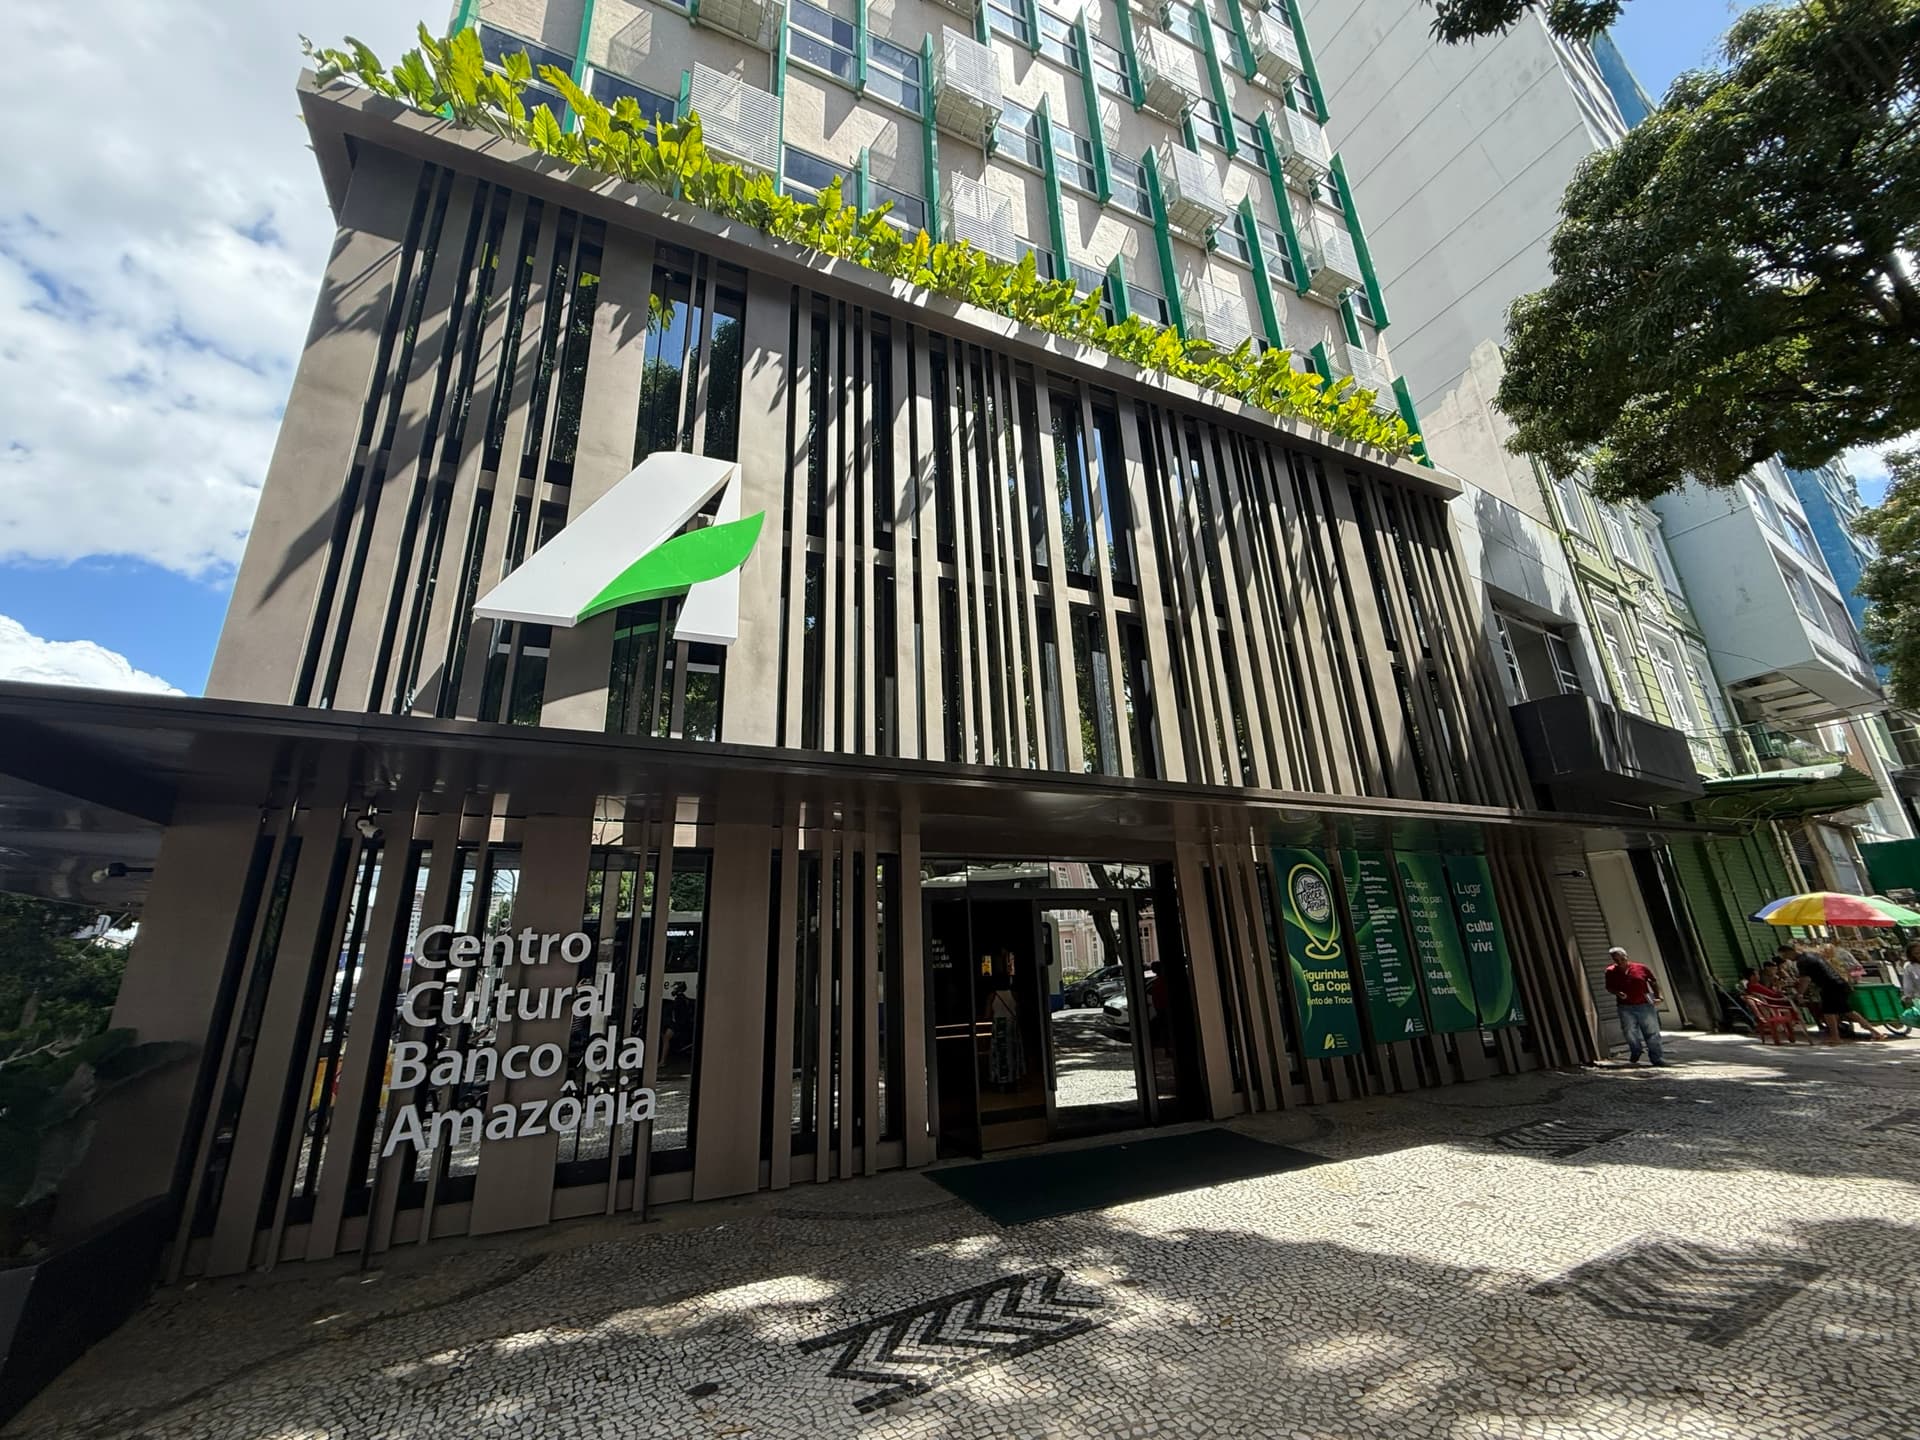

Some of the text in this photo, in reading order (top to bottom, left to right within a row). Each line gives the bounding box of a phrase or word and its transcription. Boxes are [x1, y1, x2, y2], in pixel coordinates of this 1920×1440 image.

[1456, 882, 1481, 897] Lugar
[1461, 900, 1476, 914] de
[414, 924, 592, 969] Centro
[402, 972, 616, 1027] Cultural
[1312, 981, 1325, 992] da
[1324, 996, 1333, 1005] de
[389, 1025, 645, 1091] Banco da
[382, 1076, 657, 1158] Amazônia
